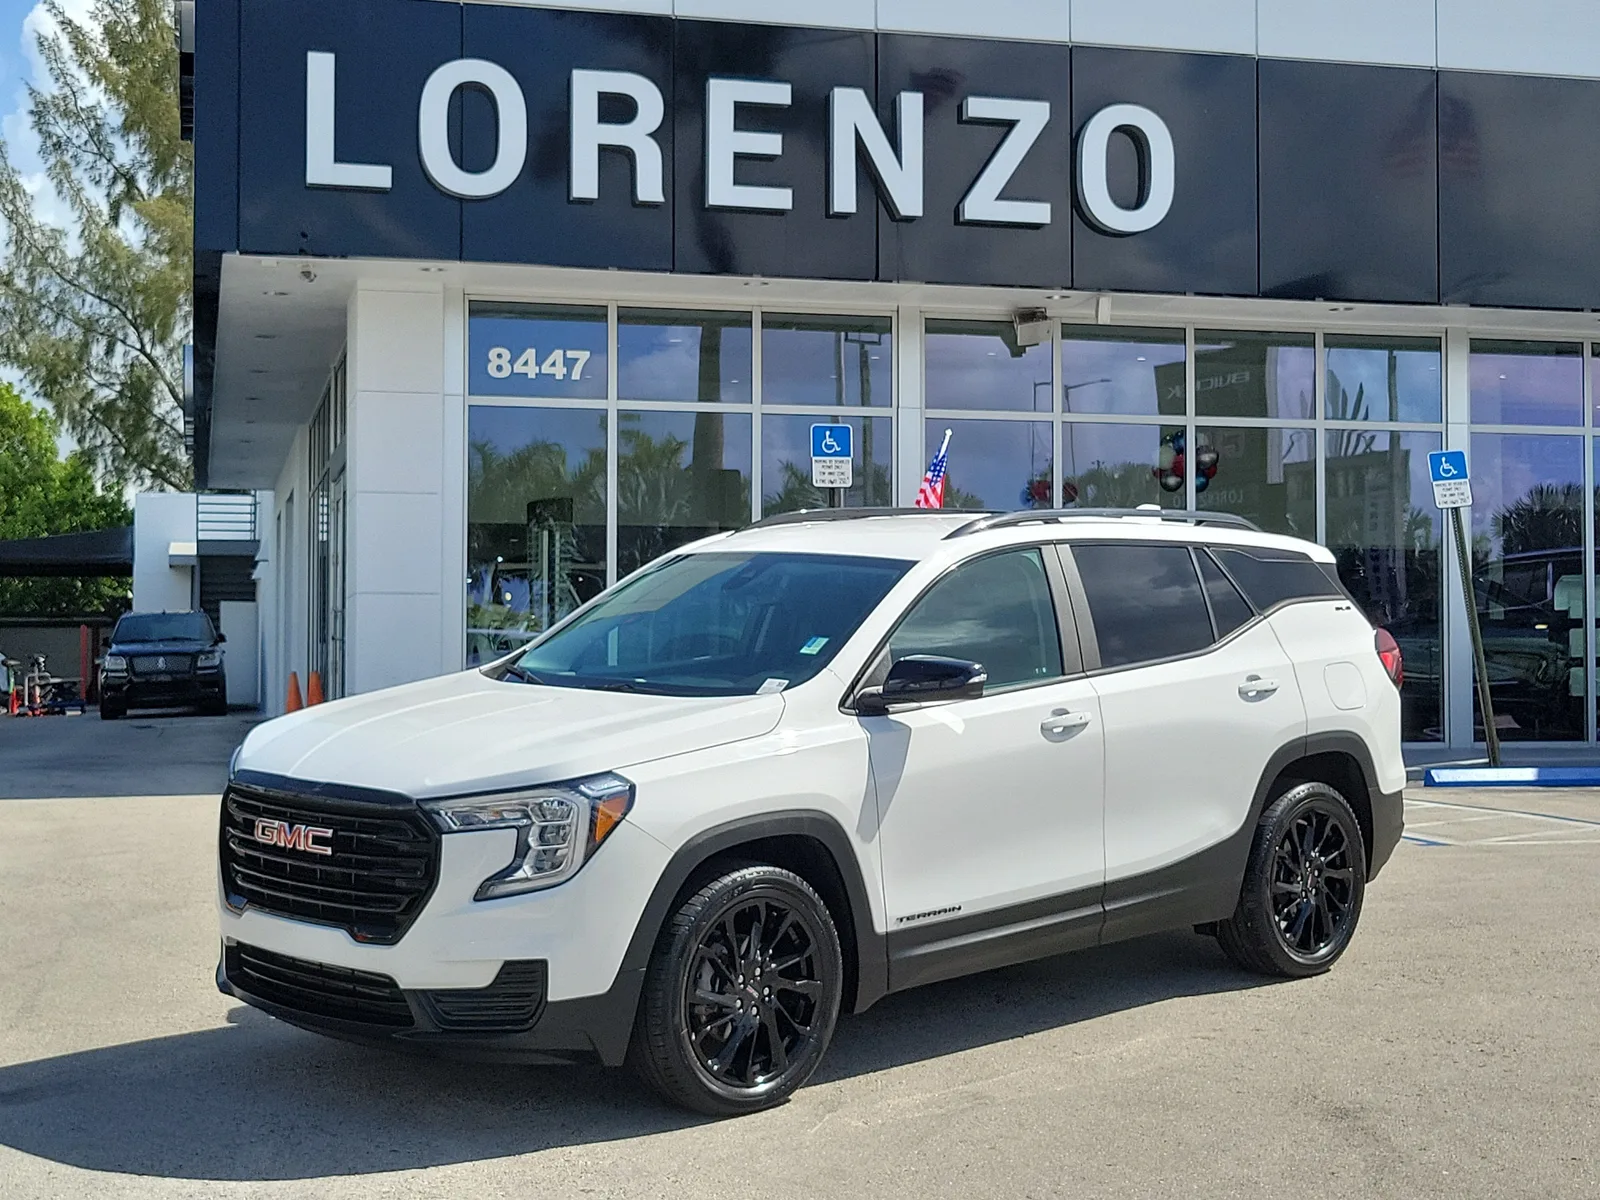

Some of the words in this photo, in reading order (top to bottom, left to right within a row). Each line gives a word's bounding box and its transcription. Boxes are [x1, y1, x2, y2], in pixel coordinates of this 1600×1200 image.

[306, 51, 1175, 235] LORENZO
[487, 347, 591, 380] 8447
[254, 817, 334, 856] GMC
[896, 905, 962, 922] TERRAIN
